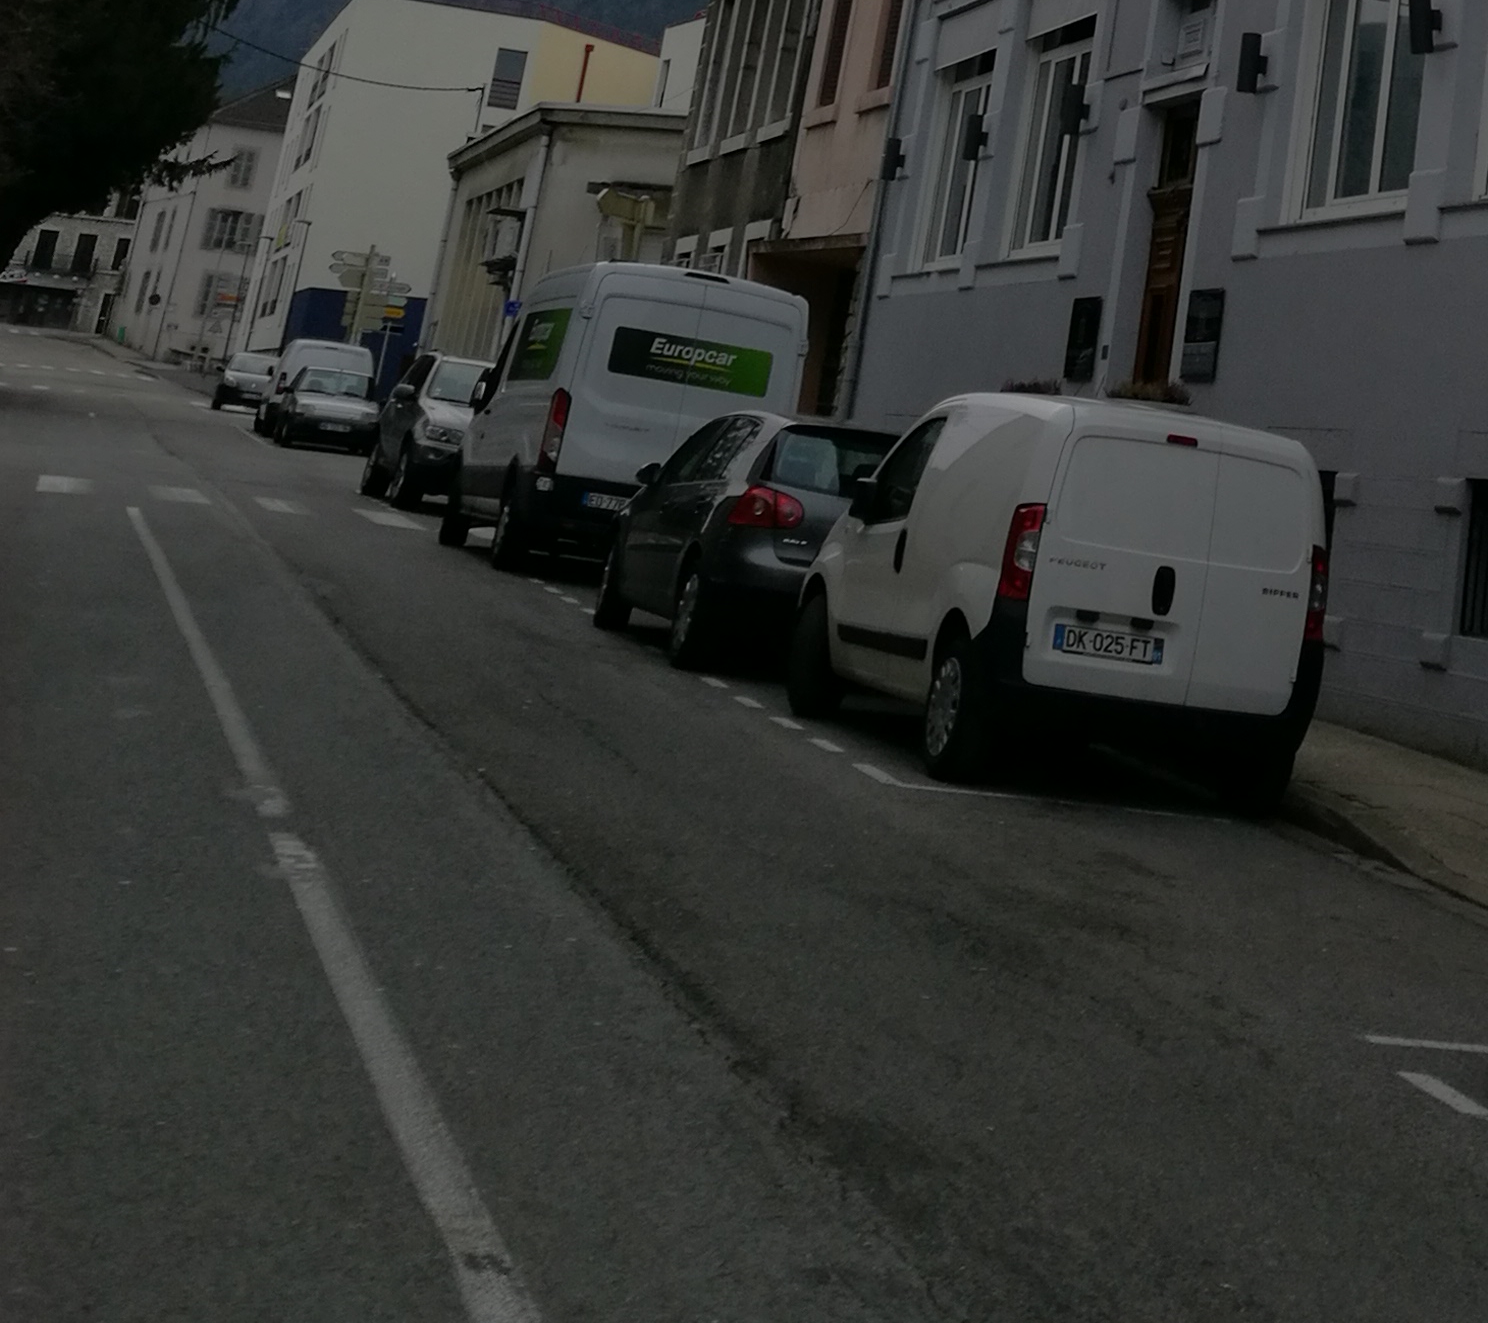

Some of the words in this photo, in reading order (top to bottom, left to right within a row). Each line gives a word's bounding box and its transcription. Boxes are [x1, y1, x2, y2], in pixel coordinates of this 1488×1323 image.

[649, 337, 737, 366] Europcar
[645, 363, 684, 380] moving
[1049, 556, 1107, 570] PEUGEOT
